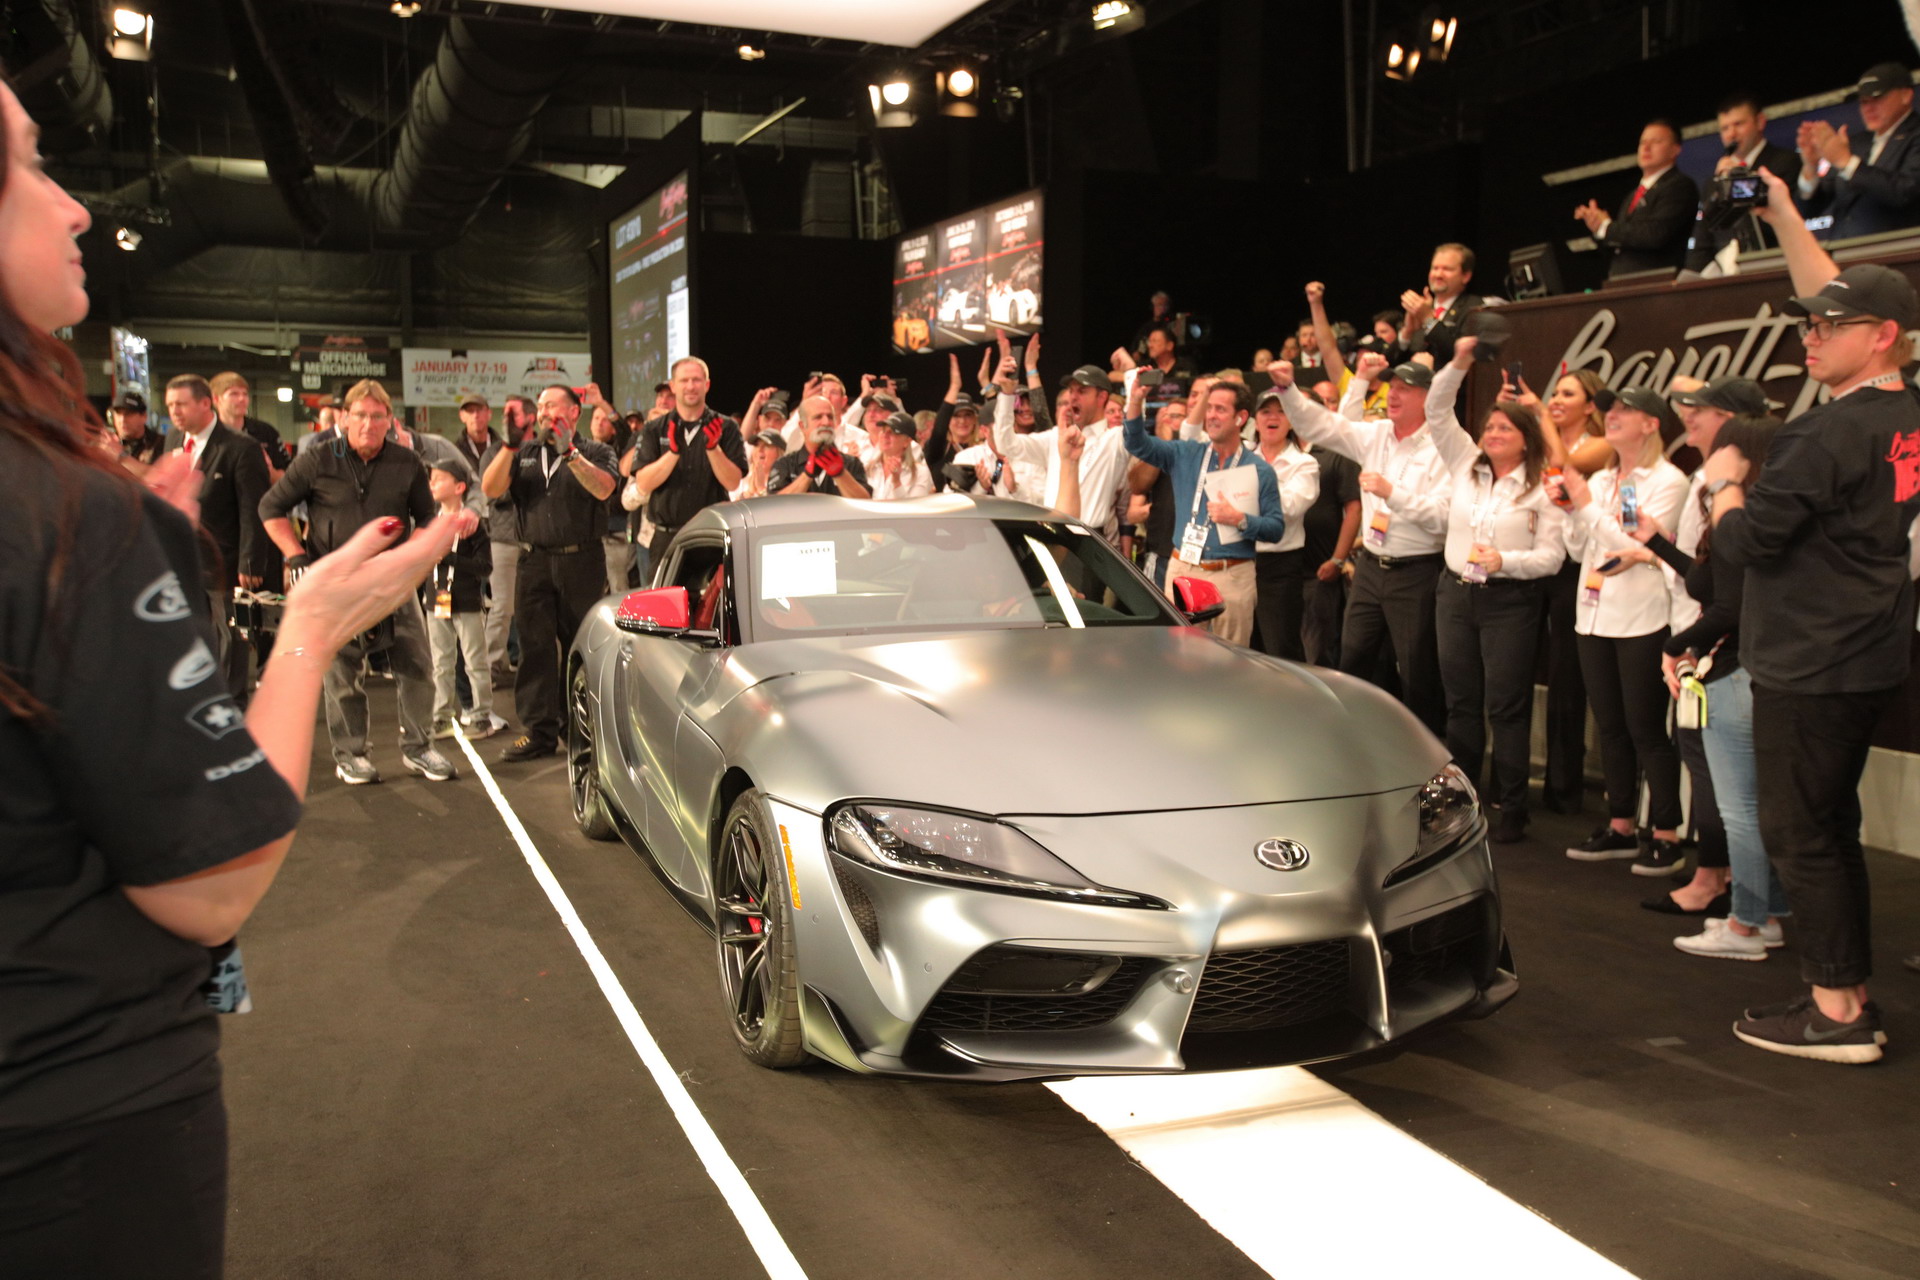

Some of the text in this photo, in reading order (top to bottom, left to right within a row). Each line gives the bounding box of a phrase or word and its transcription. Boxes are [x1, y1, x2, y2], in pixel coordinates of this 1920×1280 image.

[320, 352, 371, 364] OFFICIAL
[304, 361, 386, 377] MERCHANDISE
[412, 360, 508, 374] JANUARY 17-19
[424, 375, 459, 384] NIGHTS
[491, 375, 507, 384] PM
